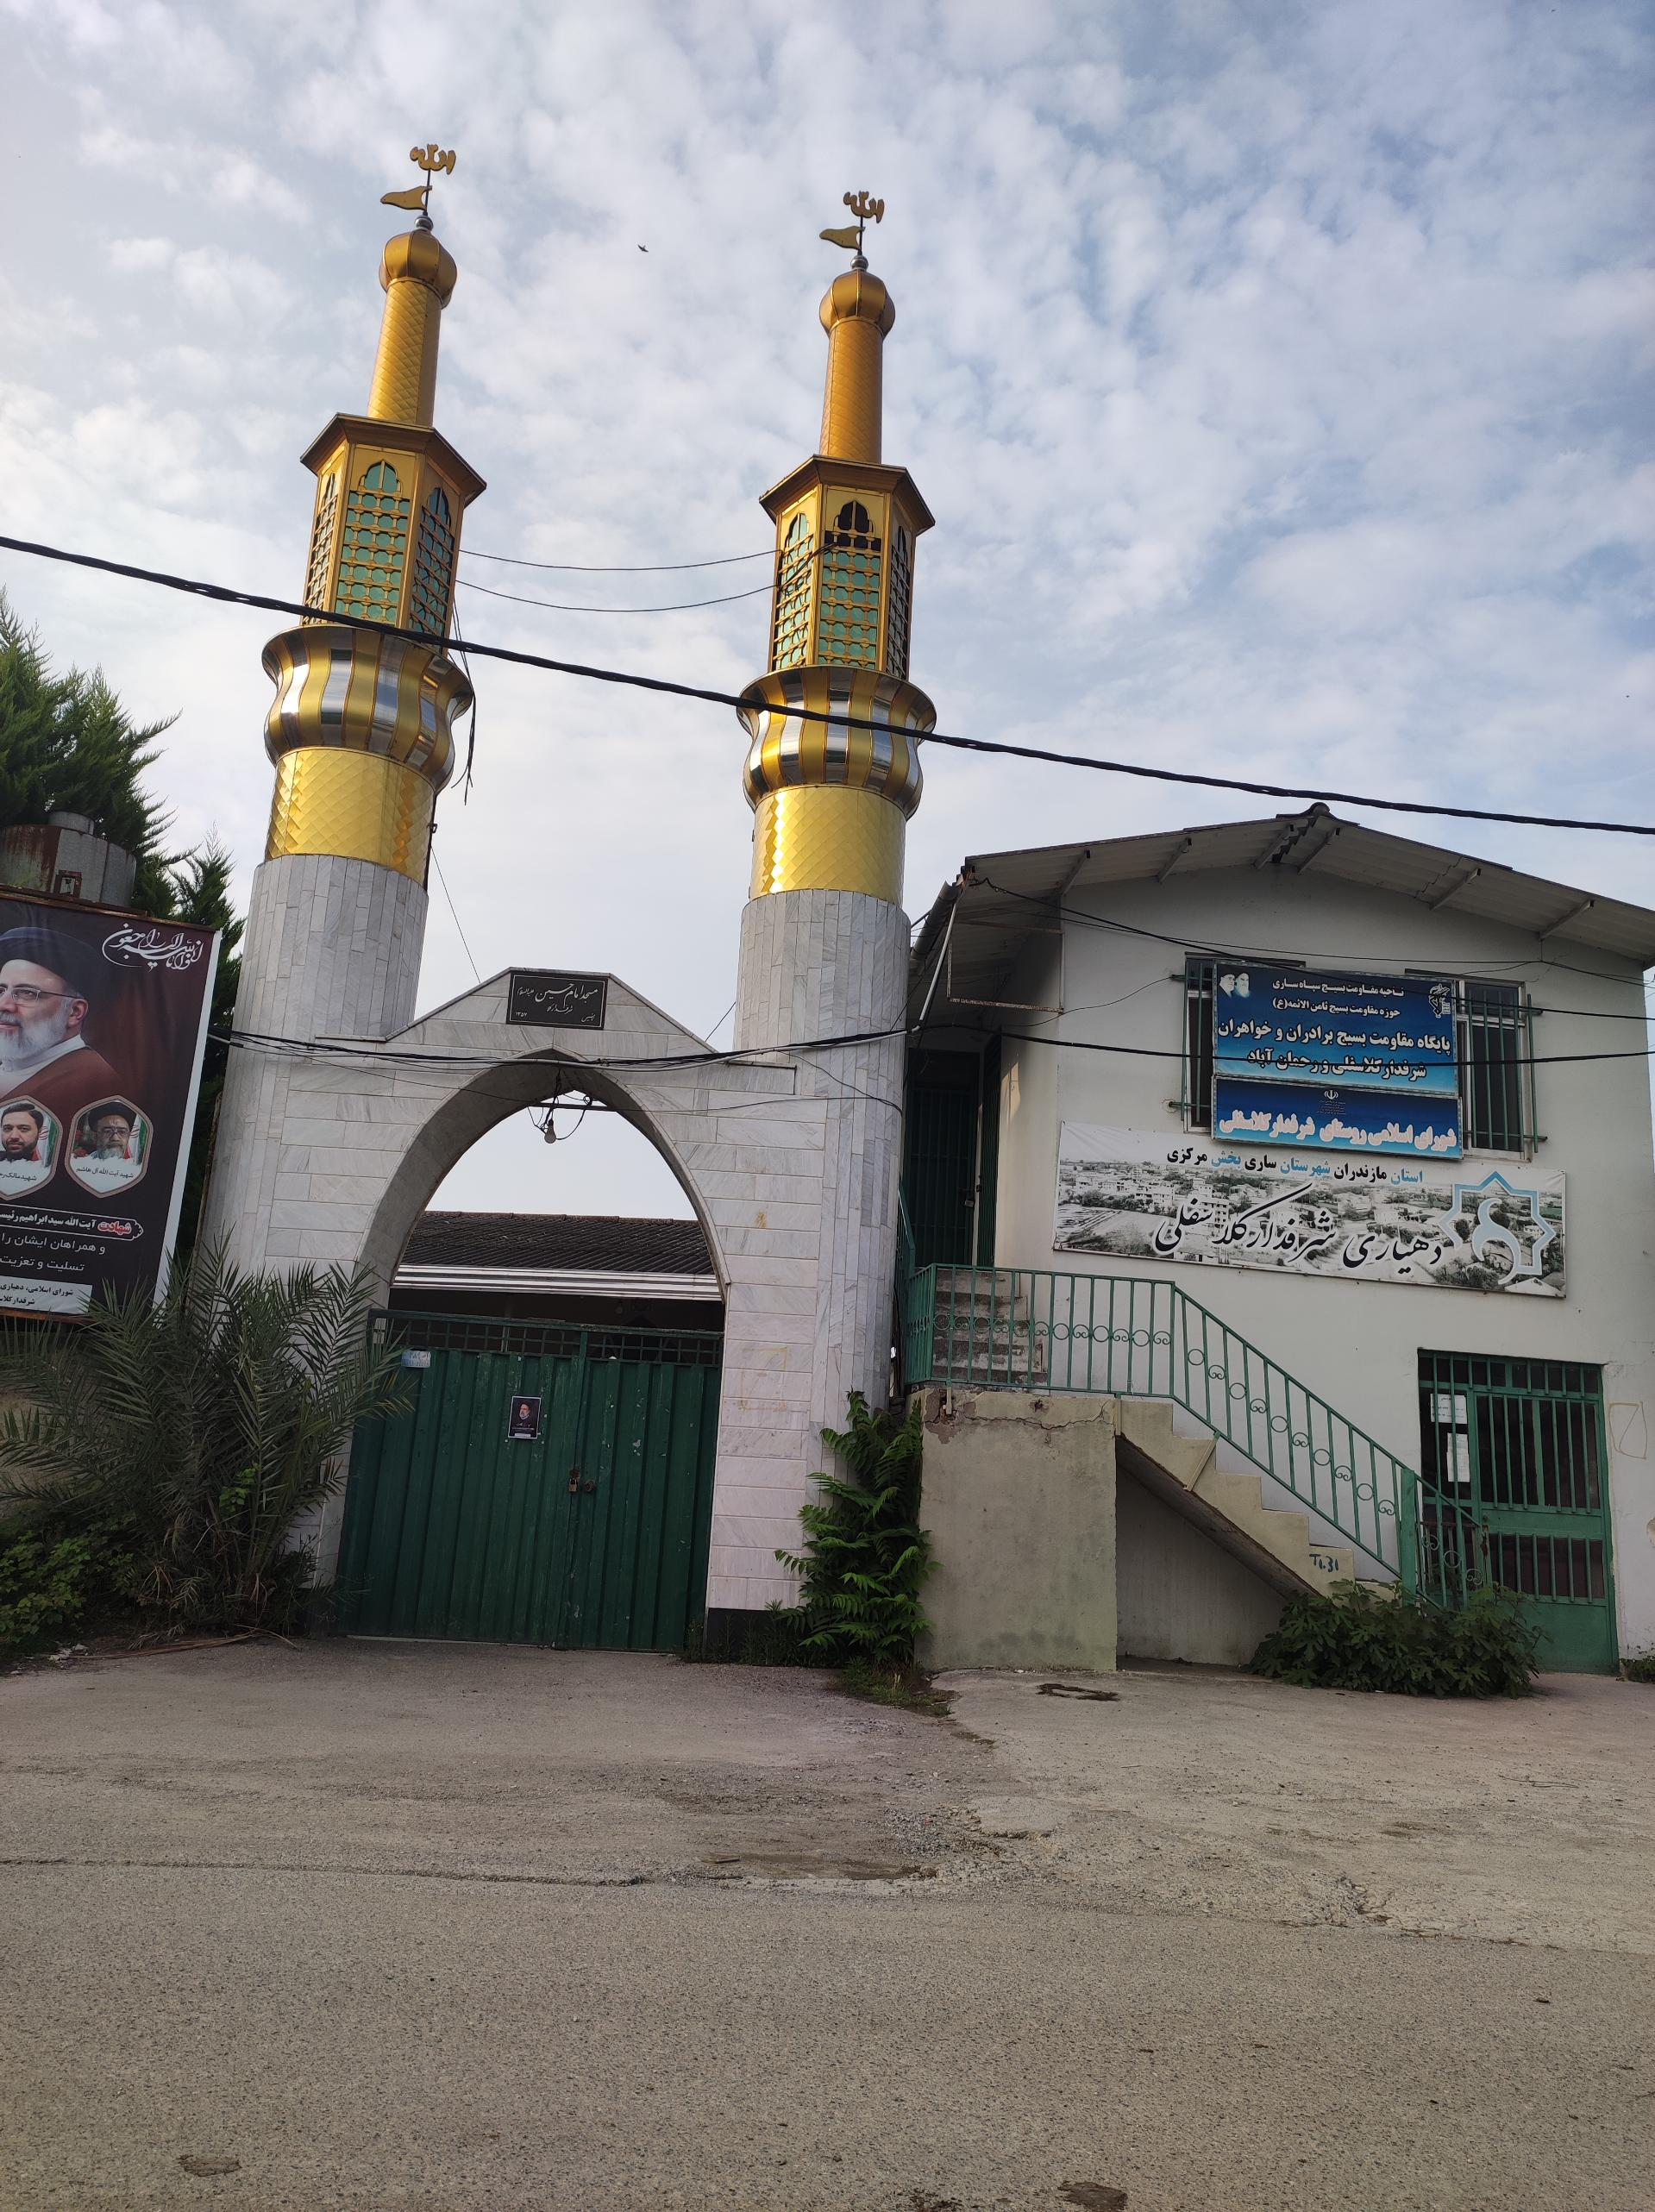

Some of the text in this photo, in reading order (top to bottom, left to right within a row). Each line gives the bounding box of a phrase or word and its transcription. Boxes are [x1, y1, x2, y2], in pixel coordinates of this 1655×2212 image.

[535, 983, 575, 1002] حسین
[562, 984, 585, 1008] امام
[580, 988, 599, 1004] مسجد
[1272, 978, 1404, 998] ناحیه مقاومت بسیج سپاه ساری
[1310, 999, 1328, 1012] ثامن
[1329, 1003, 1349, 1014] بسیج
[1349, 1005, 1379, 1016] مقاومت
[1380, 1007, 1401, 1018] حوزه
[1218, 1018, 1451, 1056] پایگاه مقاومت بسیج برادران و خواهران
[1320, 1118, 1367, 1145] روستای
[1367, 1122, 1414, 1146] اسلامی
[1414, 1125, 1457, 1152] شورای
[1167, 1148, 1423, 1186] استان مازندران شهرستان ساری بخش مرکزی
[0, 1210, 19, 1222] رئیس
[19, 1213, 47, 1225] ابراهیم
[47, 1218, 64, 1226] سید
[97, 1220, 132, 1236] شهادت
[1, 1232, 11, 1244] را
[14, 1234, 47, 1249] ایشان
[50, 1238, 97, 1254] همراهان
[1343, 1233, 1443, 1275] دهیاری
[0, 1255, 85, 1272] تسلیت و تعزیت
[52, 1288, 74, 1297] شورای
